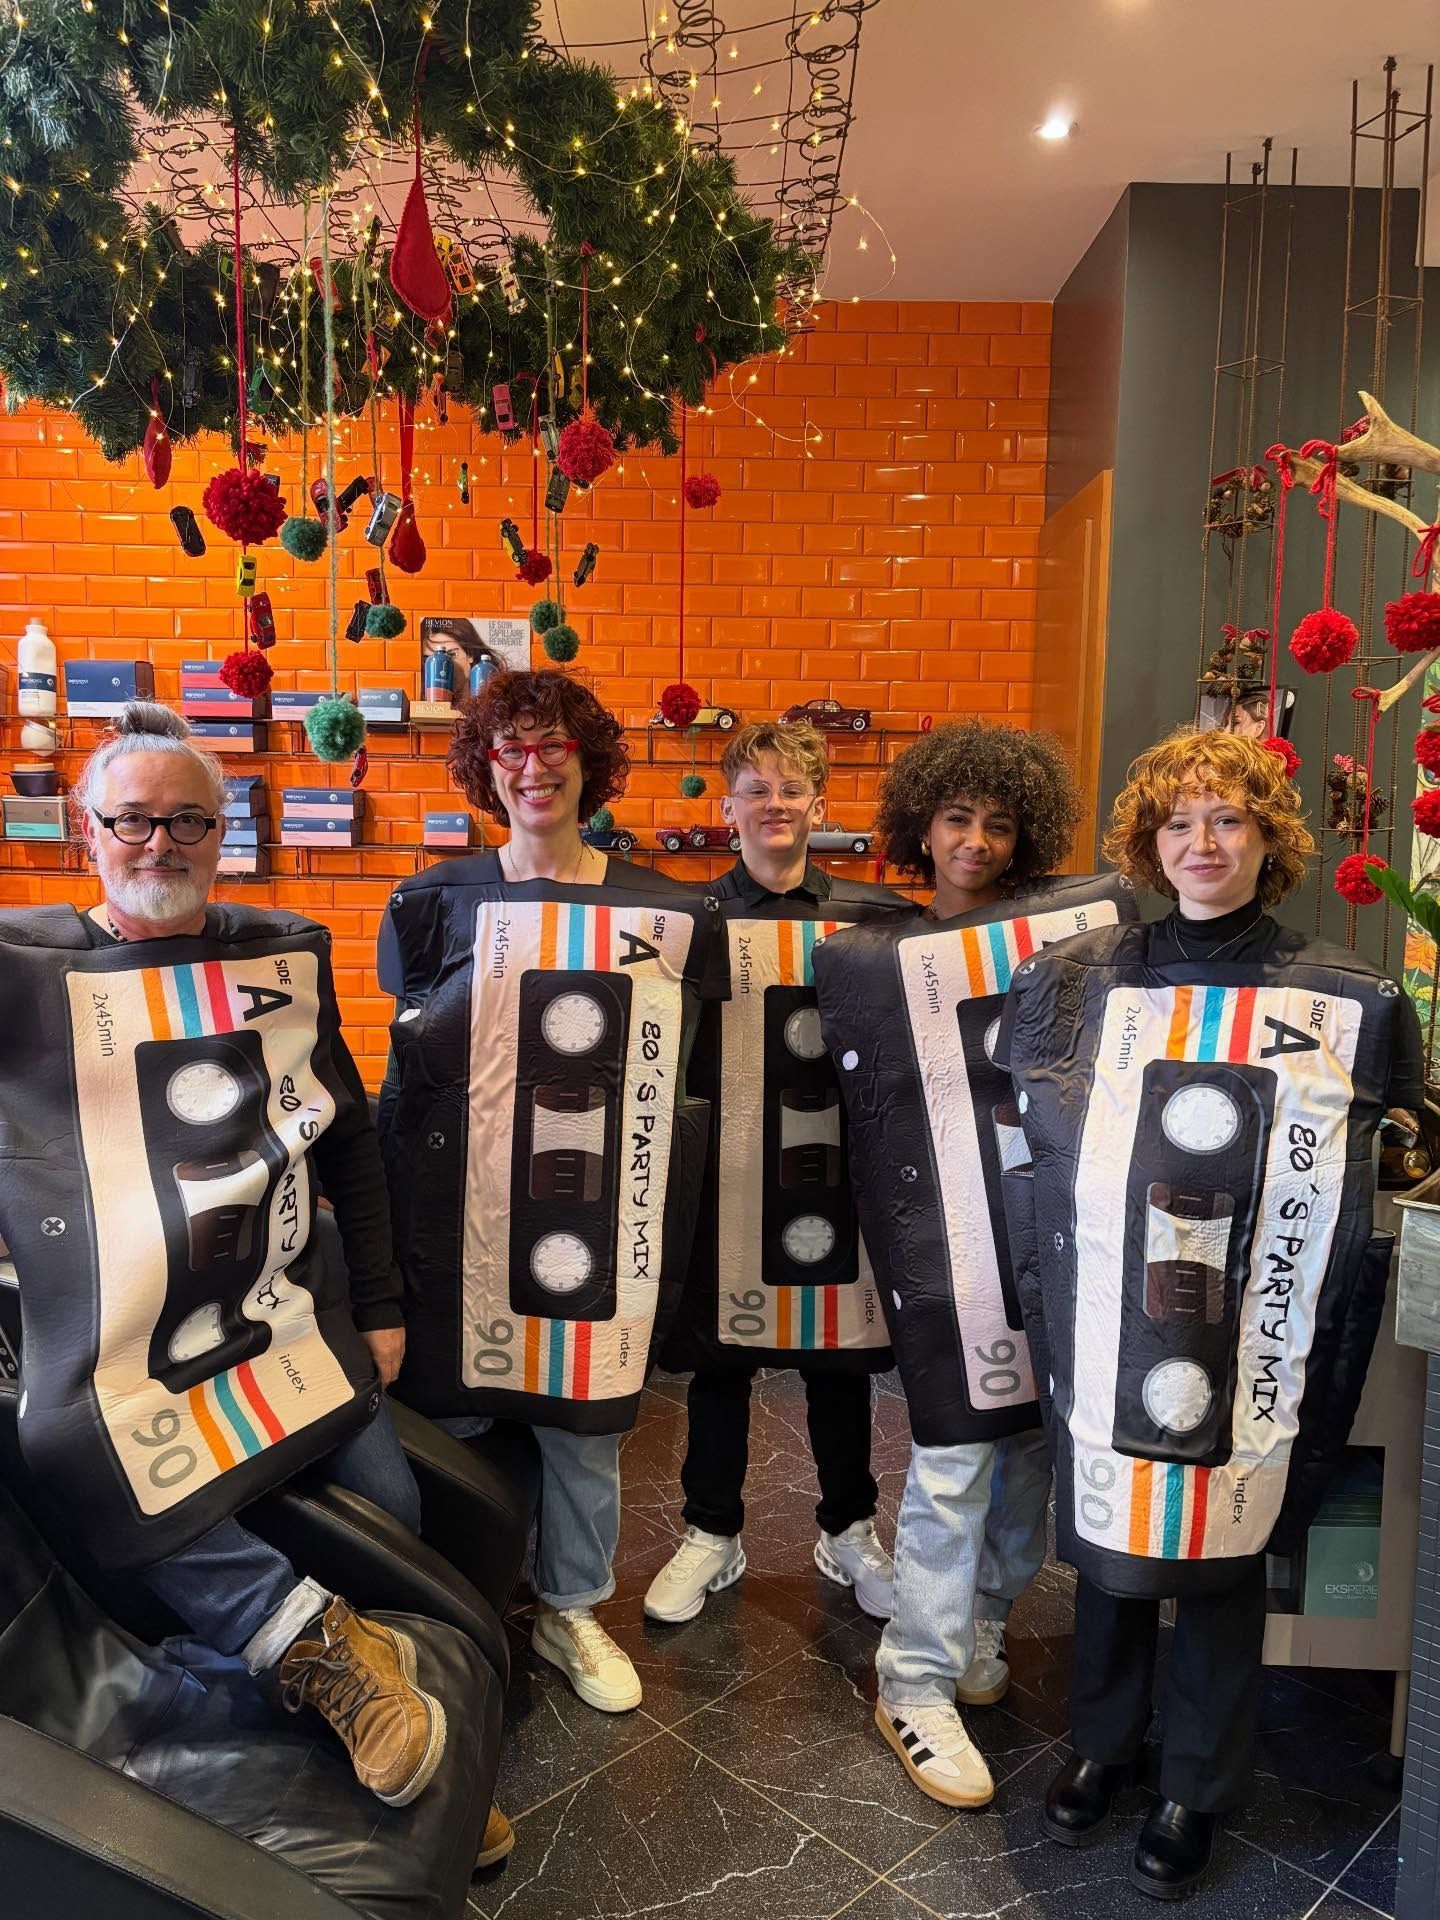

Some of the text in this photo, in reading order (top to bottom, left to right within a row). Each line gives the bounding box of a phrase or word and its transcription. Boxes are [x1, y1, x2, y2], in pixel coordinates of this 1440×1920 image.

[488, 620, 513, 629] LE SOIN
[488, 628, 525, 638] CAPILLAIRE
[652, 914, 666, 942] SIDE
[1074, 911, 1088, 931] SID
[273, 958, 292, 985] SIDE
[492, 919, 511, 980] 2x45min
[619, 930, 660, 967] A
[738, 935, 753, 995] 2x45min
[236, 984, 293, 1022] A
[919, 952, 941, 1015] 2x45min
[92, 992, 114, 1057] 2x45min
[1117, 1005, 1139, 1071] 2x45min
[1259, 1014, 1322, 1060] A
[1309, 999, 1326, 1031] SIDE
[631, 1020, 665, 1280] 80'S PARTY MIX
[279, 1162, 298, 1252] ARTY
[1252, 1122, 1319, 1424] 80'S PARTY MIX
[729, 1289, 767, 1337] 90
[863, 1288, 876, 1326] index
[473, 1318, 515, 1377] 90
[619, 1327, 632, 1369] index
[974, 1338, 1022, 1397] 90
[278, 1352, 307, 1395] index
[130, 1408, 198, 1489] 90
[1078, 1458, 1118, 1530] 90
[1232, 1475, 1248, 1526] index
